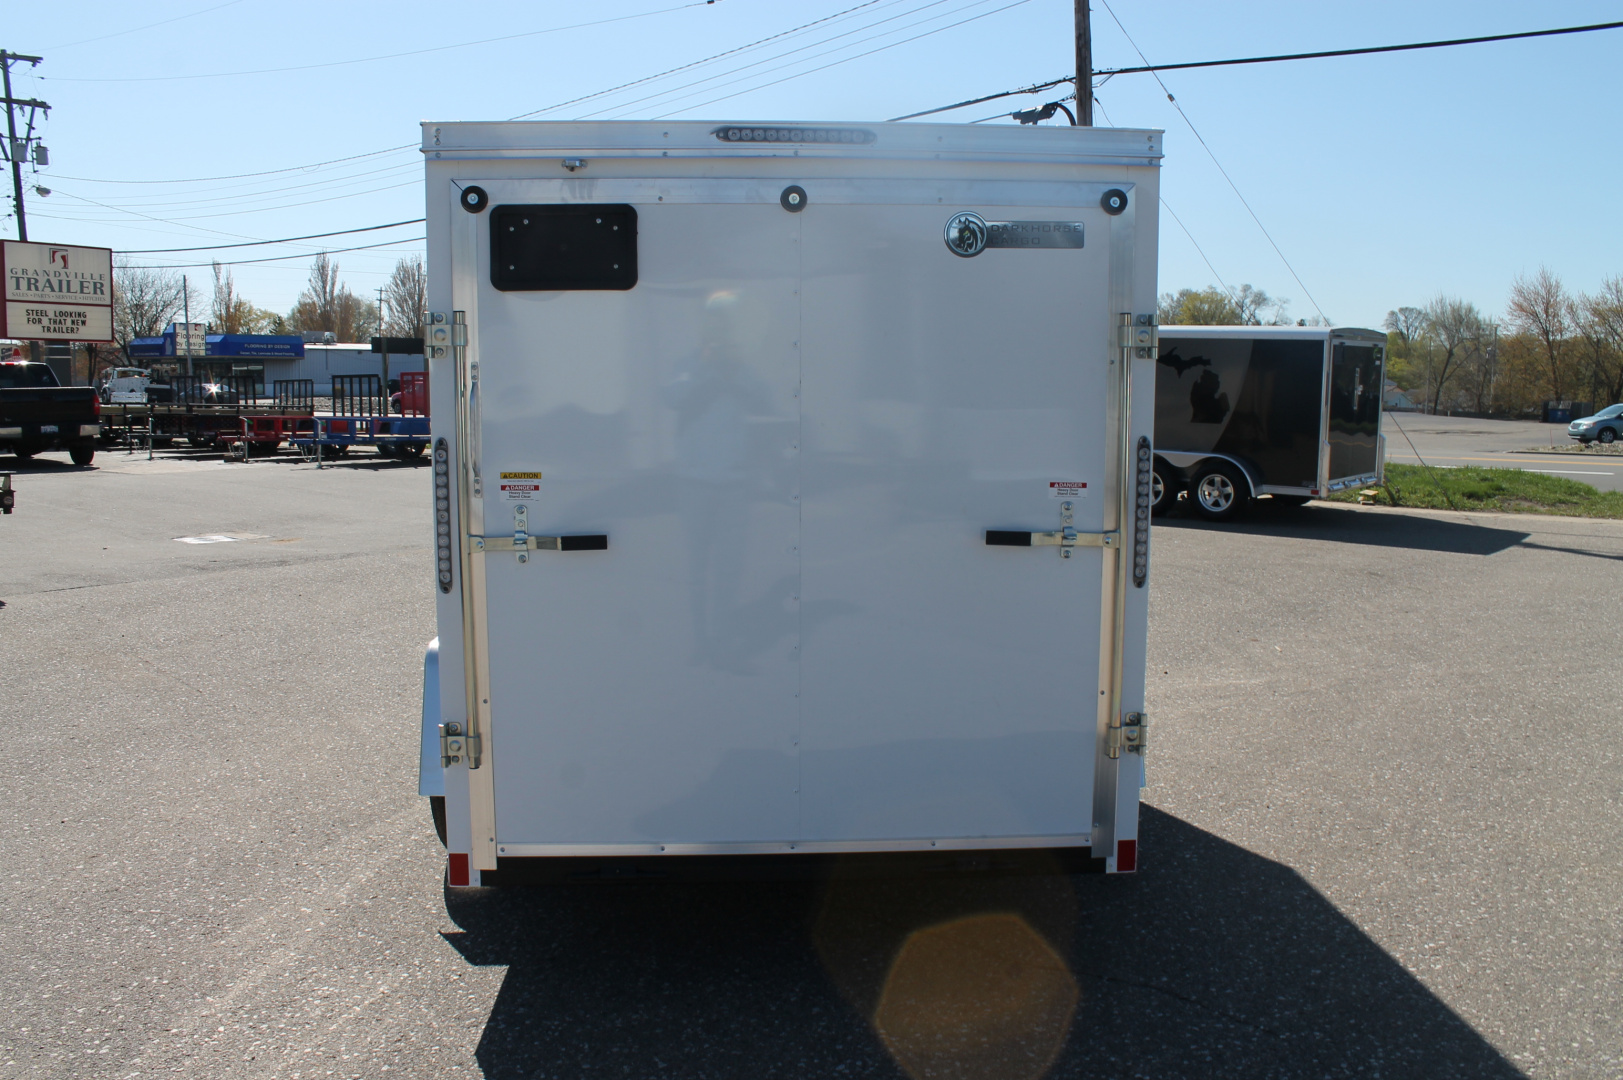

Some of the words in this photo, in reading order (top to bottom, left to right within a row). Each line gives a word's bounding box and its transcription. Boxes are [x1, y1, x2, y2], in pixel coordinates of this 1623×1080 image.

[991, 224, 1080, 232] DARKHORSE
[991, 236, 1040, 244] CARGO
[10, 268, 105, 280] GRANDVILLE
[10, 276, 105, 295] TRAILER
[54, 310, 87, 318] LOOKING
[176, 332, 204, 341] Flooring
